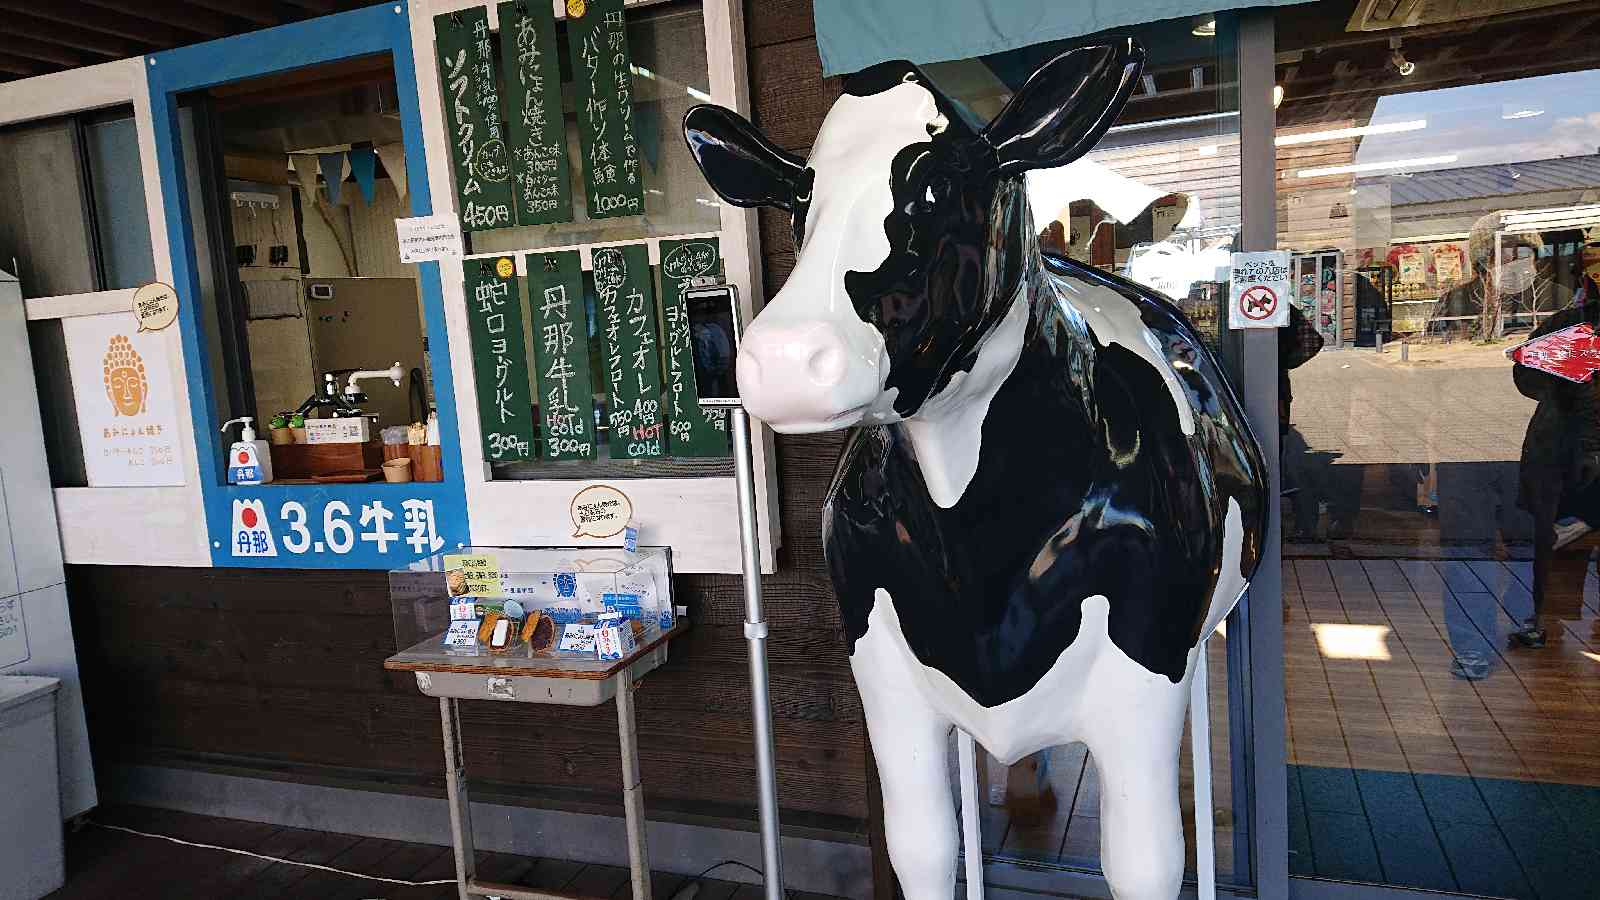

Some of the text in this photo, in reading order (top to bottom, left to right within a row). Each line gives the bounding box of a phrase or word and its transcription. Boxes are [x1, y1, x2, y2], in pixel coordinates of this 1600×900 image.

[515, 16, 546, 146] あみにょん焼き
[582, 25, 617, 185] バター作り体験
[444, 48, 482, 196] ソフトクリーム
[463, 201, 509, 228] 450円
[593, 192, 639, 214] 1000円
[1245, 259, 1276, 268] ペットを
[474, 278, 516, 425] 蛇口ヨーグルト
[539, 284, 579, 414] 丹那牛乳
[599, 288, 627, 409] カフェオレフロート
[625, 288, 656, 395] カフェオレ
[665, 305, 684, 418] ヨーグルトフロート
[488, 432, 529, 459] 300円
[548, 438, 592, 459] 300円
[670, 420, 692, 443] 600円
[236, 468, 255, 480] 丹那
[237, 530, 269, 554] 丹那
[280, 498, 445, 556] 3.6牛乳
